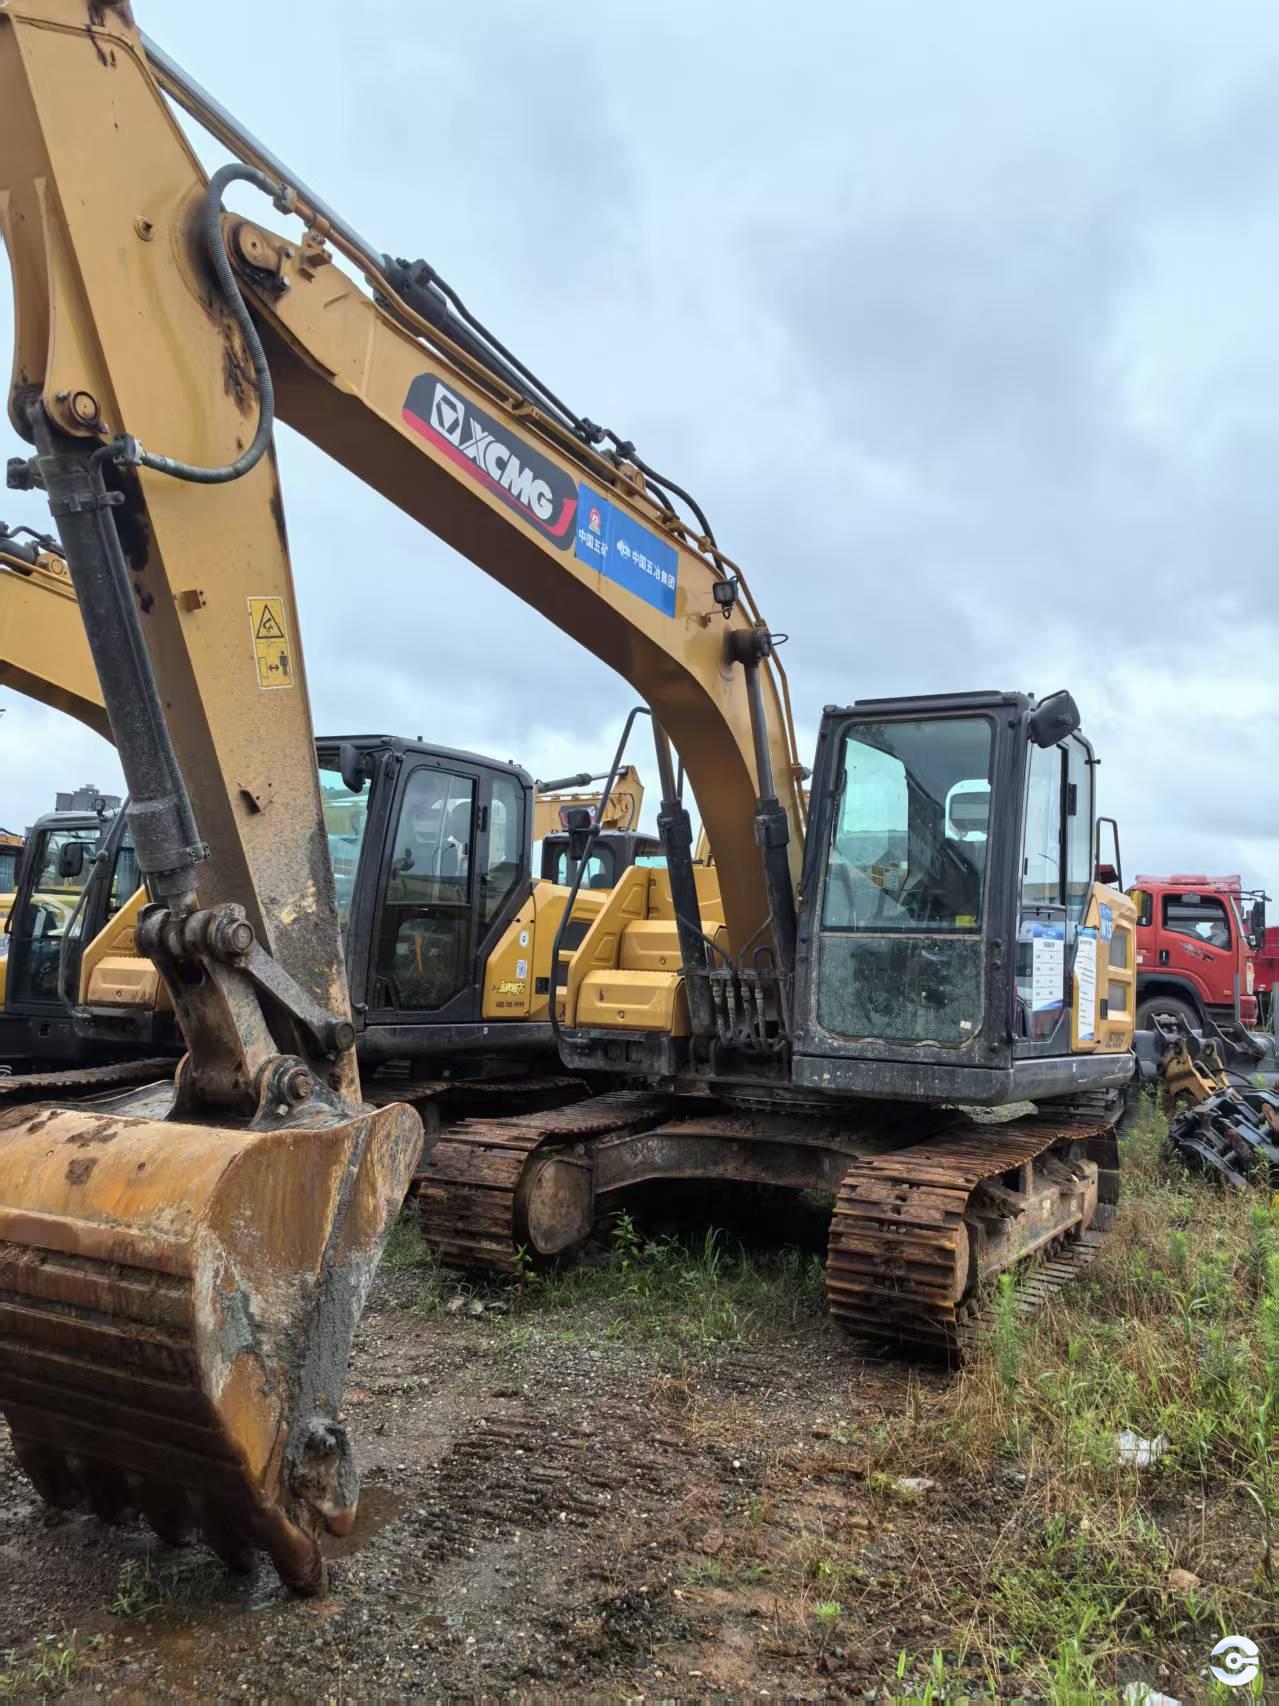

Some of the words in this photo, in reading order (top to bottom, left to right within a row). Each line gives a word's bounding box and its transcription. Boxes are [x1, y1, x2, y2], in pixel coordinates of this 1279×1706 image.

[459, 417, 553, 520] XCMG
[578, 529, 609, 557] 中国五矿
